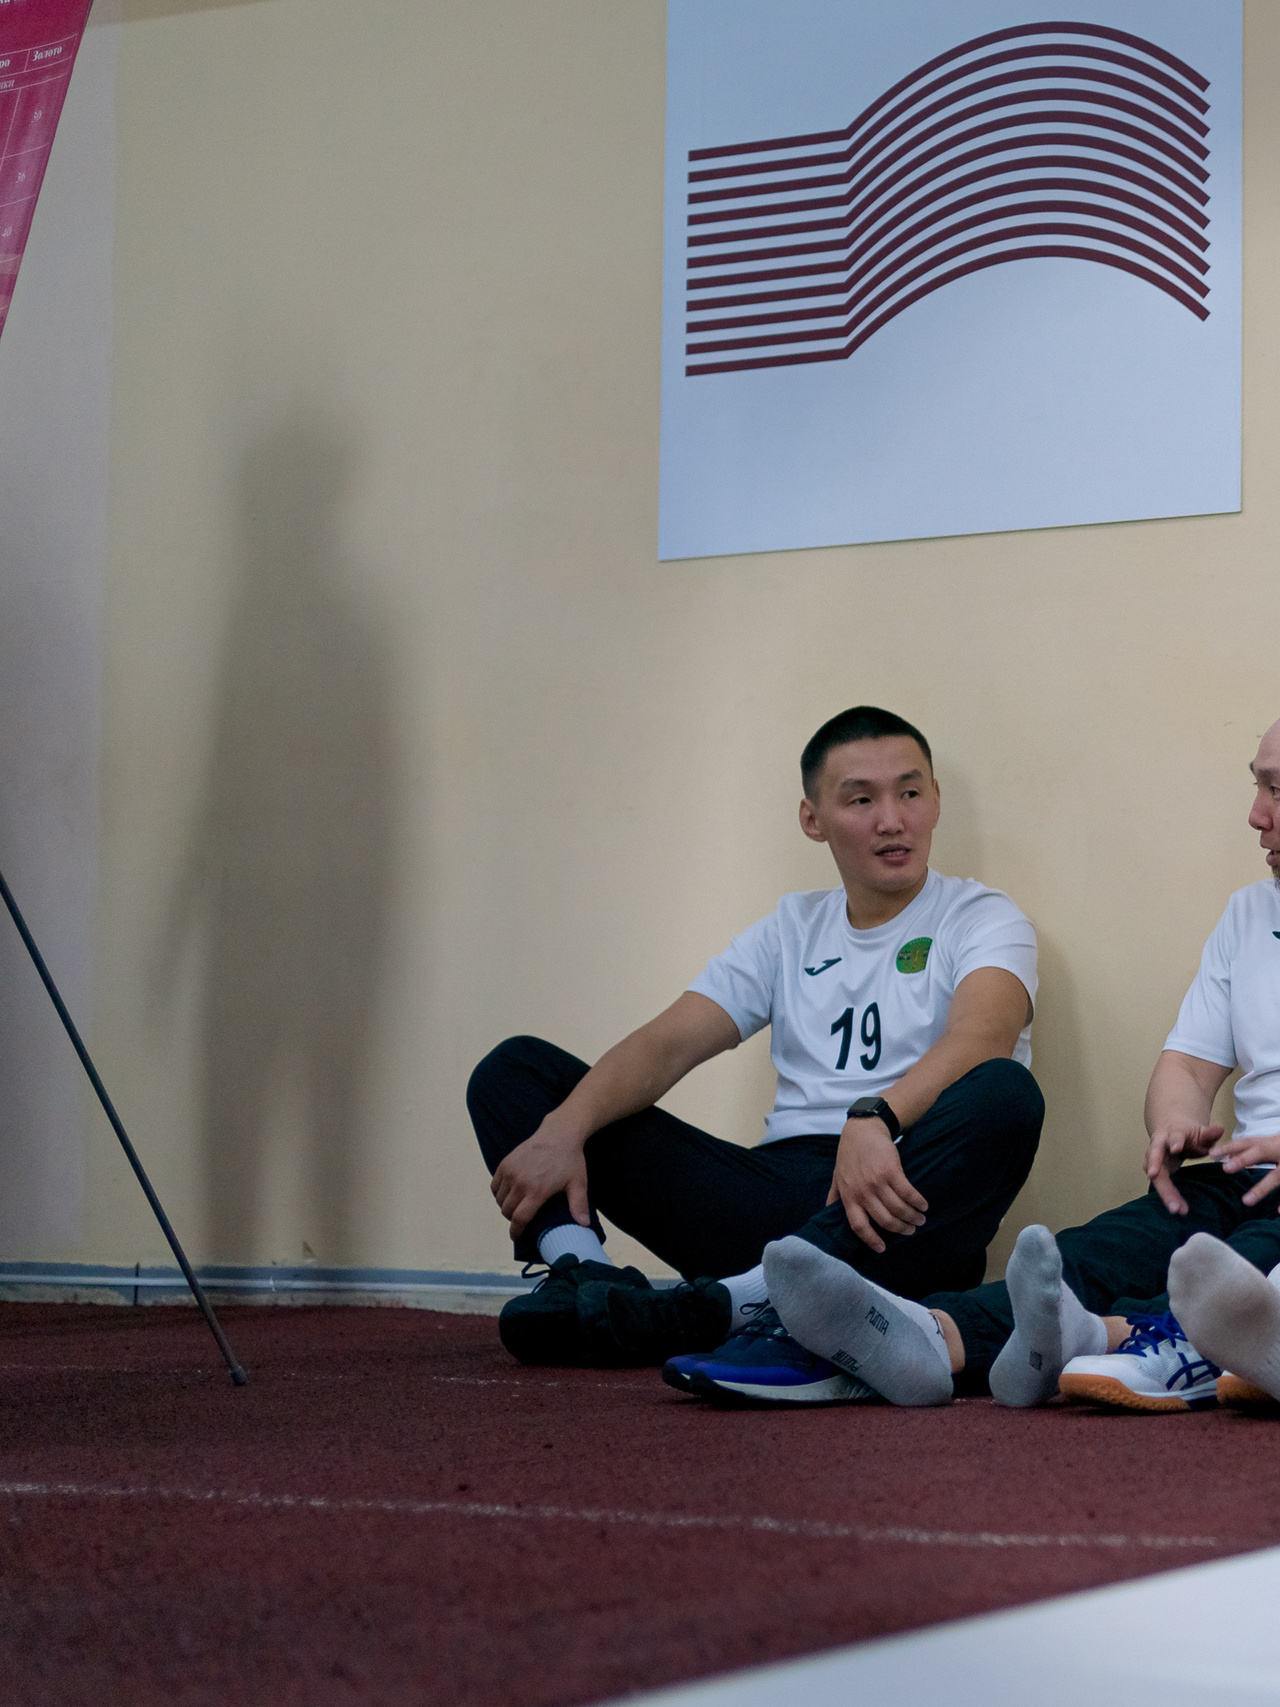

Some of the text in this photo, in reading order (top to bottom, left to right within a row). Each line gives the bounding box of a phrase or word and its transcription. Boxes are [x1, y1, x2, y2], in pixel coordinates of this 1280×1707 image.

[33, 46, 62, 61] Золото
[830, 1001, 882, 1071] 19
[865, 1306, 890, 1336] PUMA
